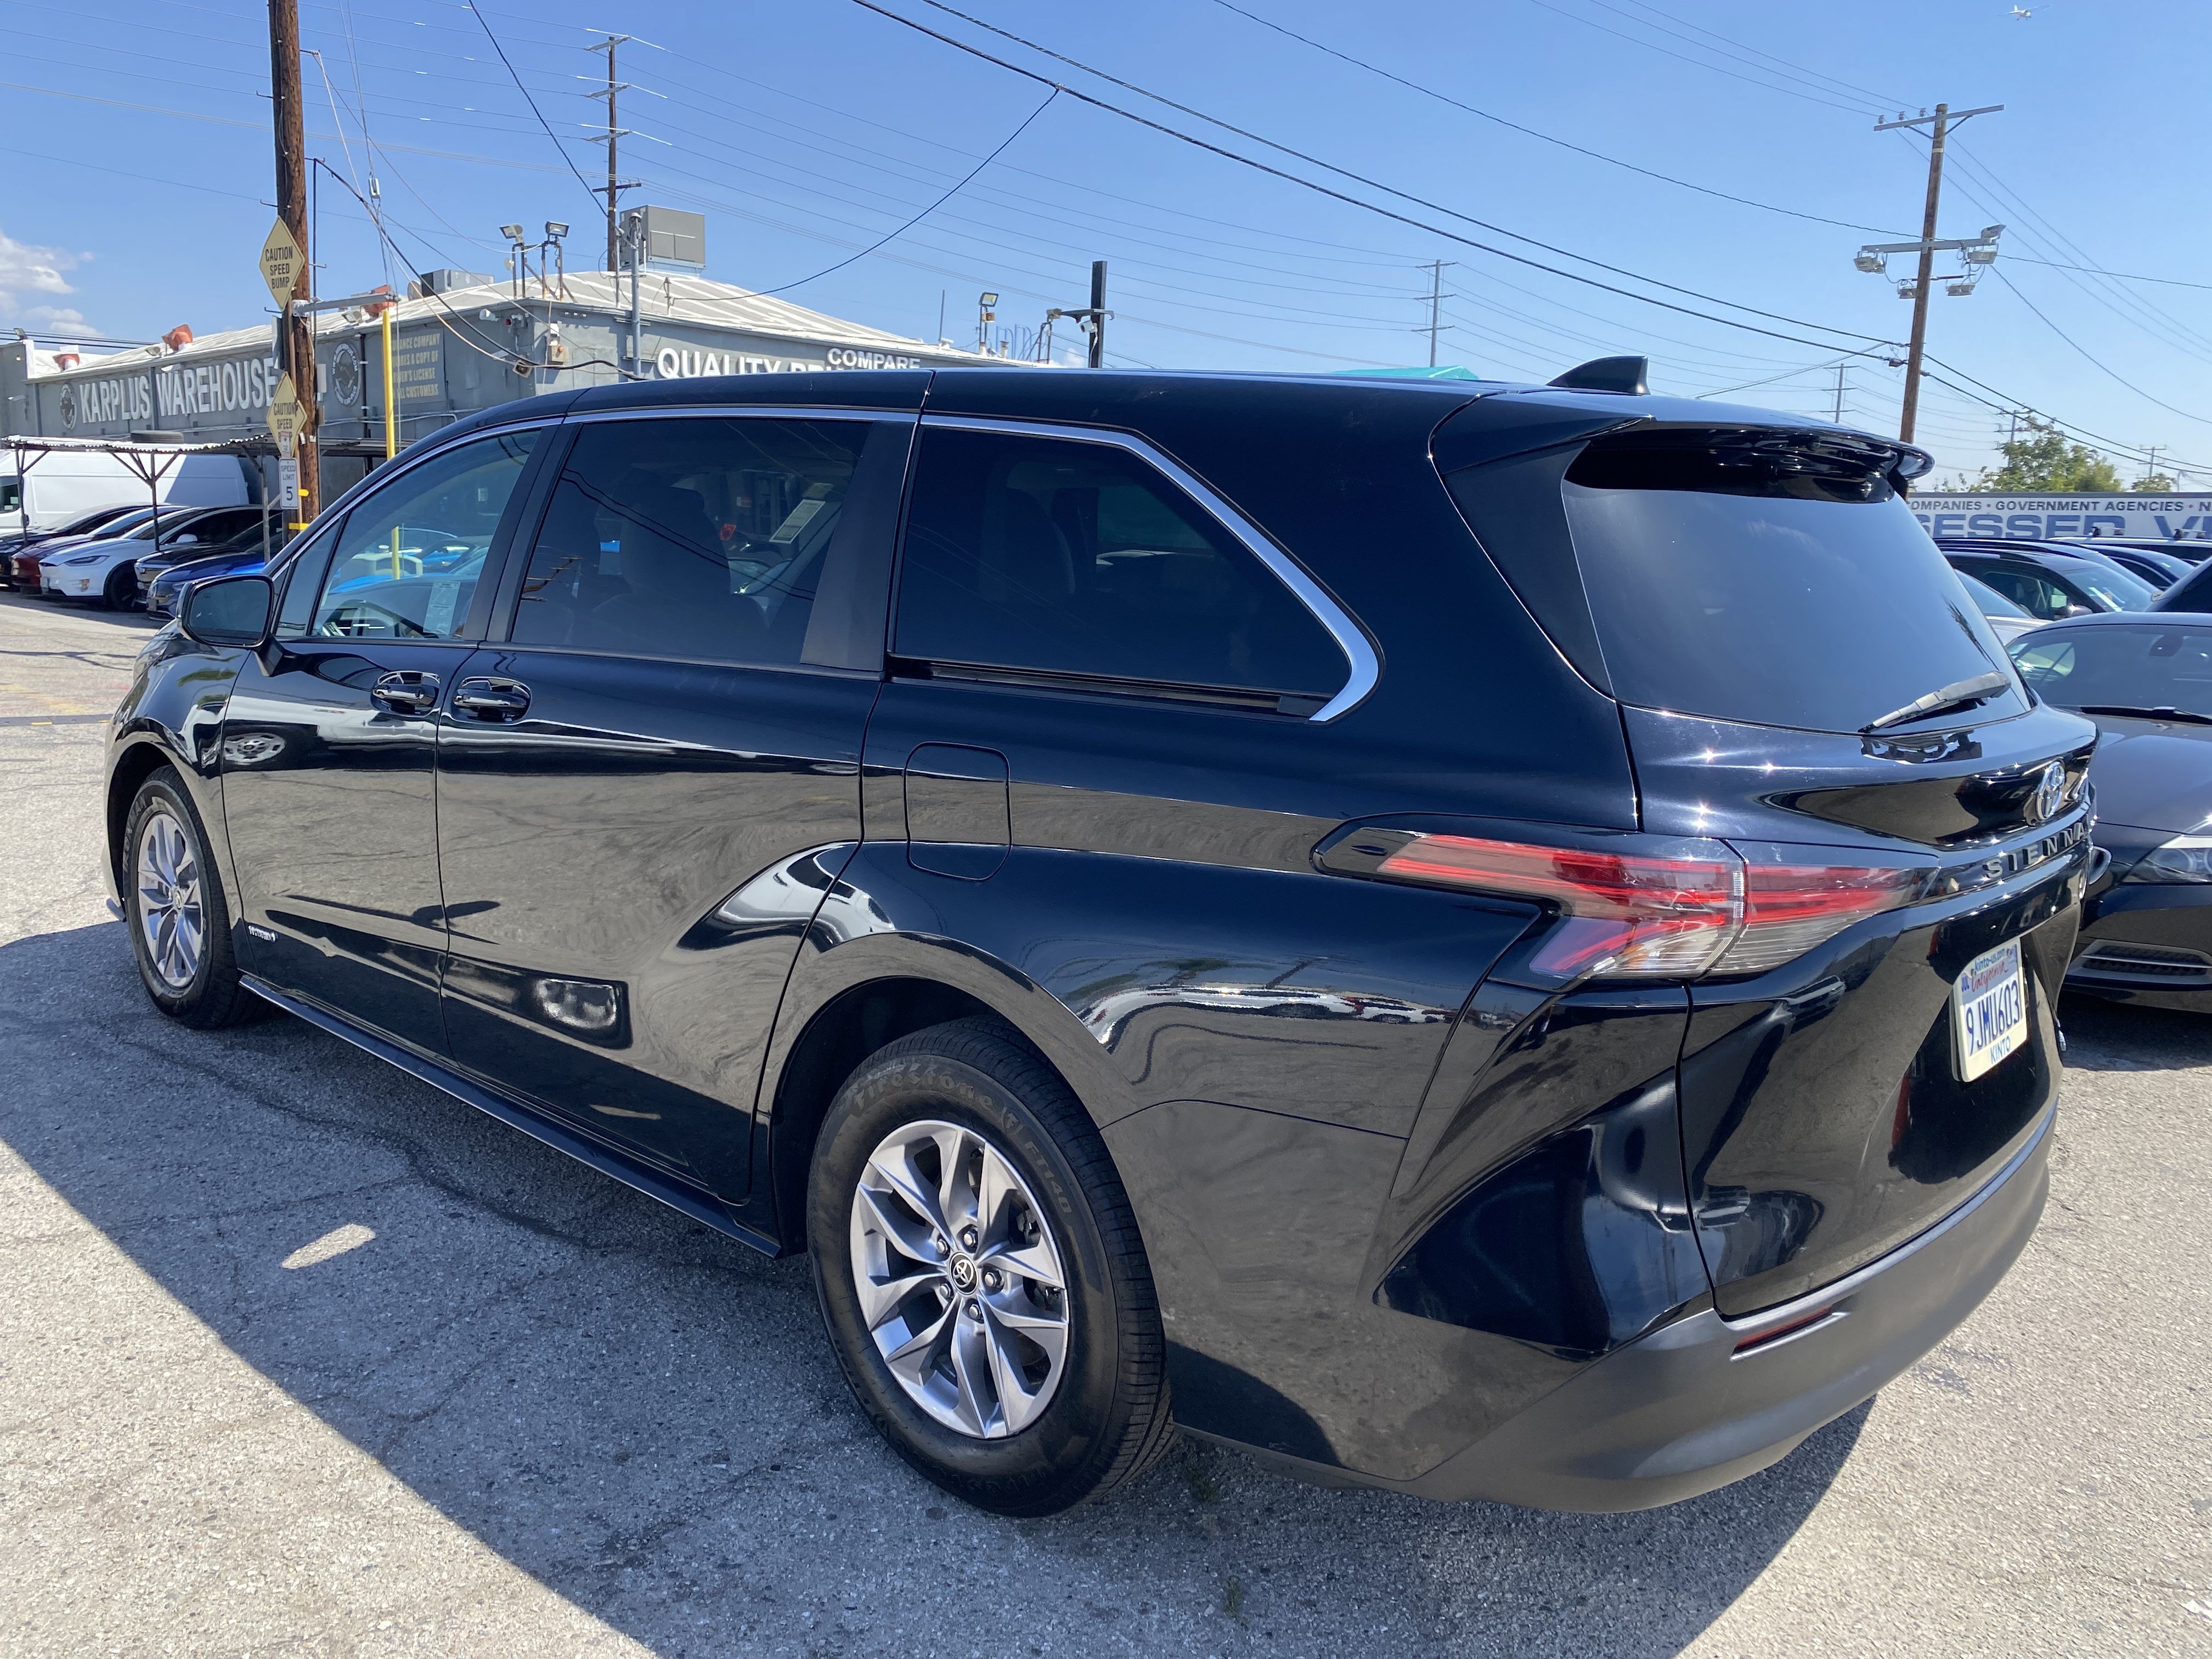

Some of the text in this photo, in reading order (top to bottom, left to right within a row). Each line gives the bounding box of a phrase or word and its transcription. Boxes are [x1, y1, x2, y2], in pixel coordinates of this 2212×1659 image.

[265, 246, 293, 262] CAUTION
[269, 263, 290, 276] SPEED
[271, 276, 290, 289] BUMP
[414, 333, 440, 348] COMPANY
[411, 353, 415, 365] A
[416, 351, 430, 364] COPY
[431, 350, 438, 362] OF
[658, 348, 781, 379] QUALITY
[827, 347, 920, 369] COMPARE
[413, 367, 436, 381] LICENSE
[79, 376, 151, 423] KARPLUS
[155, 358, 278, 416] WAREHOUSE
[406, 383, 438, 398] CUSTOMERS
[274, 402, 296, 416] CAUTION
[276, 419, 292, 430] SPEED
[286, 486, 293, 501] 5
[1995, 500, 2100, 511] GOVERNMENT
[2104, 501, 2184, 512] AGENCIES
[2198, 501, 2212, 512] N
[1984, 822, 2085, 878] SIENNA
[1971, 961, 2008, 992] California
[1966, 980, 2019, 1057] 9JMU603
[1990, 1035, 2011, 1064] KINTO
[1025, 1141, 1073, 1213] FT140
